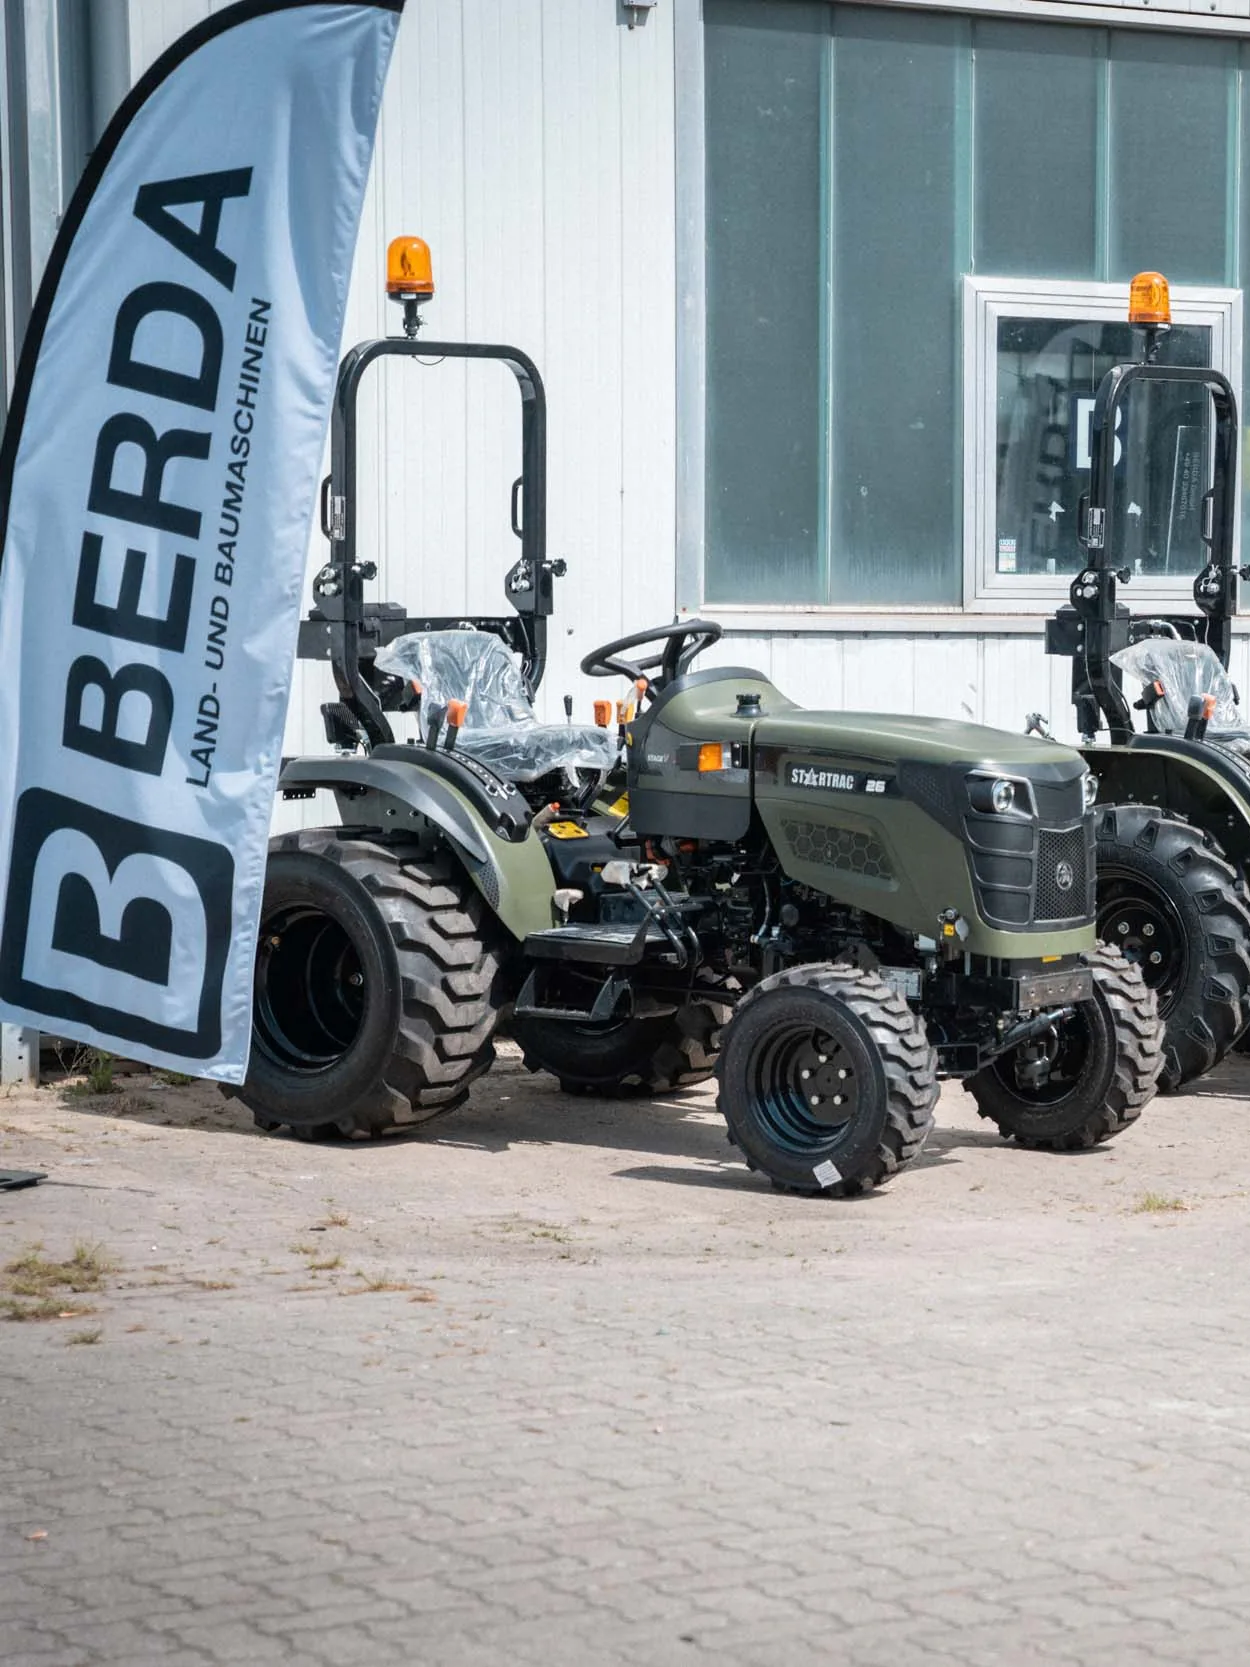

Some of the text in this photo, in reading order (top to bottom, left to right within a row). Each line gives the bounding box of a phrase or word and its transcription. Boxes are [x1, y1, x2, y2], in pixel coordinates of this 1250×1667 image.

[63, 165, 253, 777] BERDA
[186, 297, 272, 788] LAND- UND BAUMASCHINEN
[21, 823, 207, 1034] B
